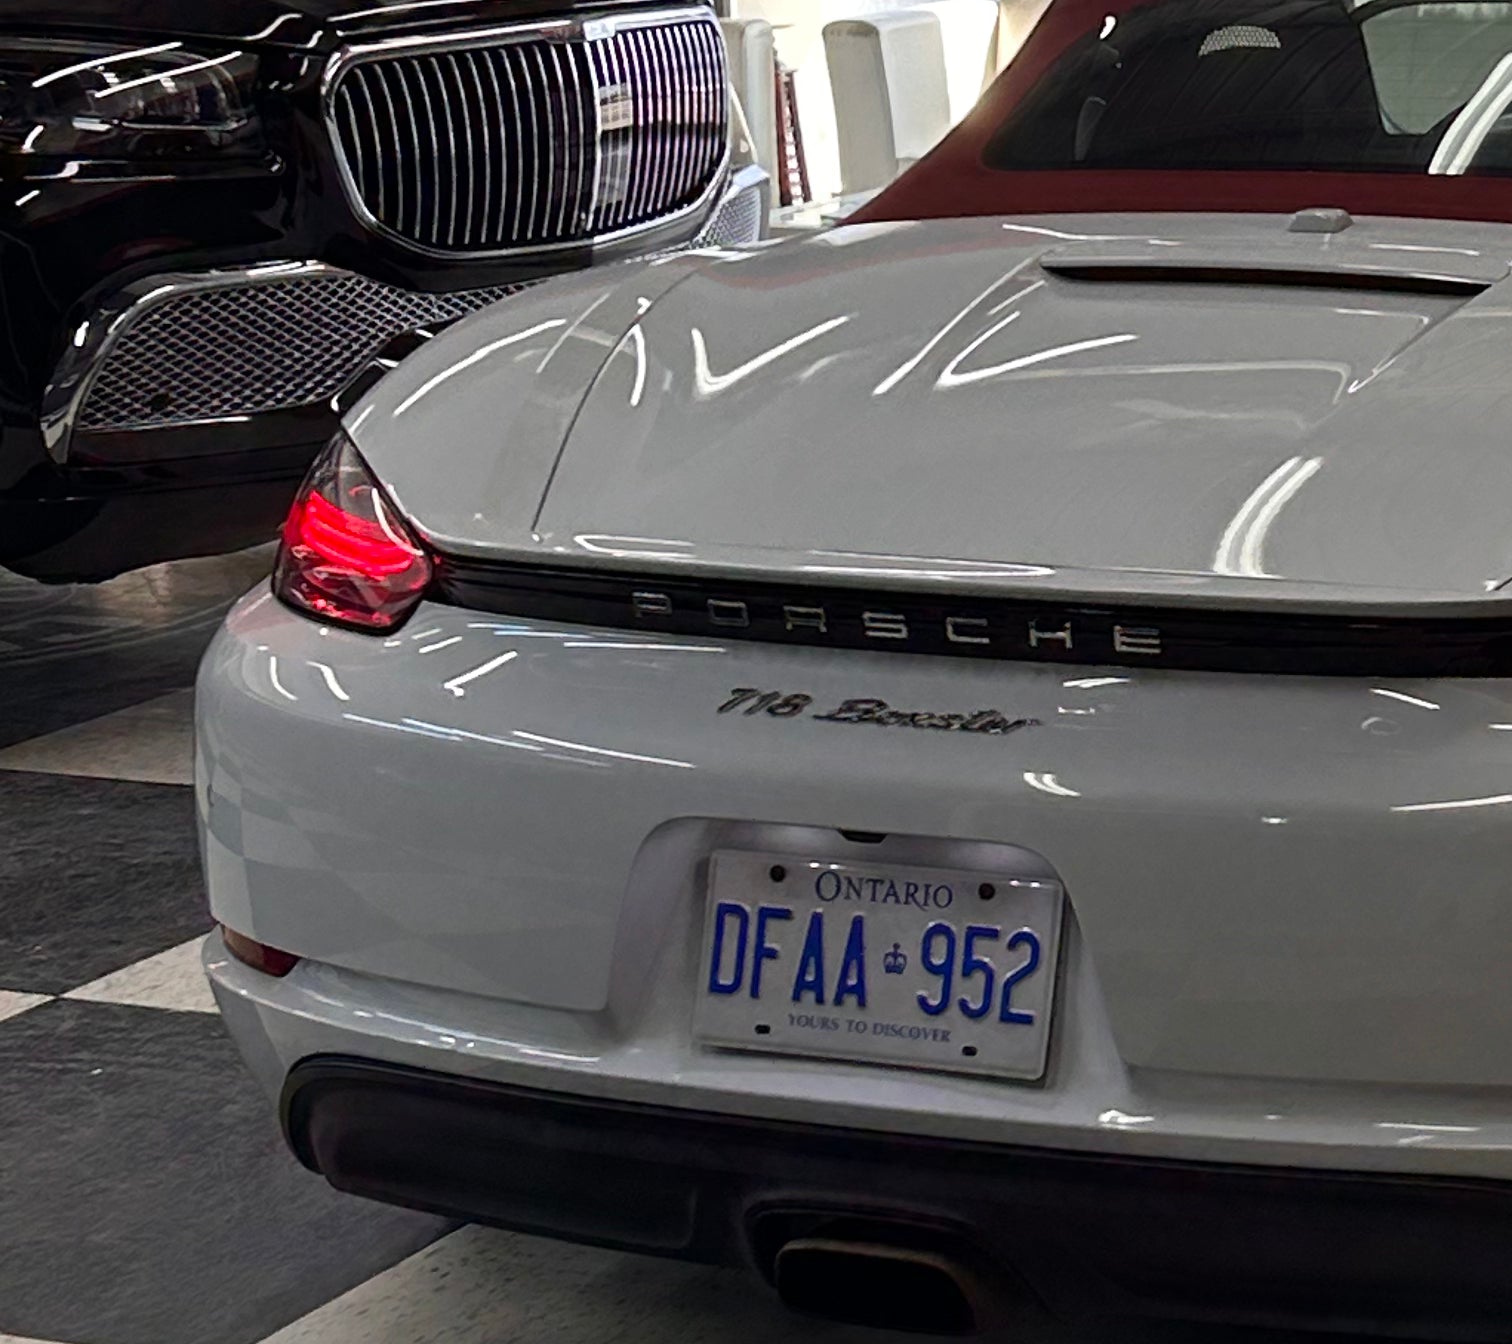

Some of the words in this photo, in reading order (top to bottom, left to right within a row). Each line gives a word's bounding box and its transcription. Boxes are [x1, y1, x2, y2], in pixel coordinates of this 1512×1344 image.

[632, 591, 1162, 654] PORSCHE
[717, 687, 813, 716] 718
[812, 697, 1043, 735] Boxster
[709, 901, 867, 1008] DFAA
[917, 921, 1041, 1025] 952
[788, 1013, 840, 1030] YOURS
[846, 1019, 868, 1034] TO
[872, 1022, 951, 1042] DISCOVER
